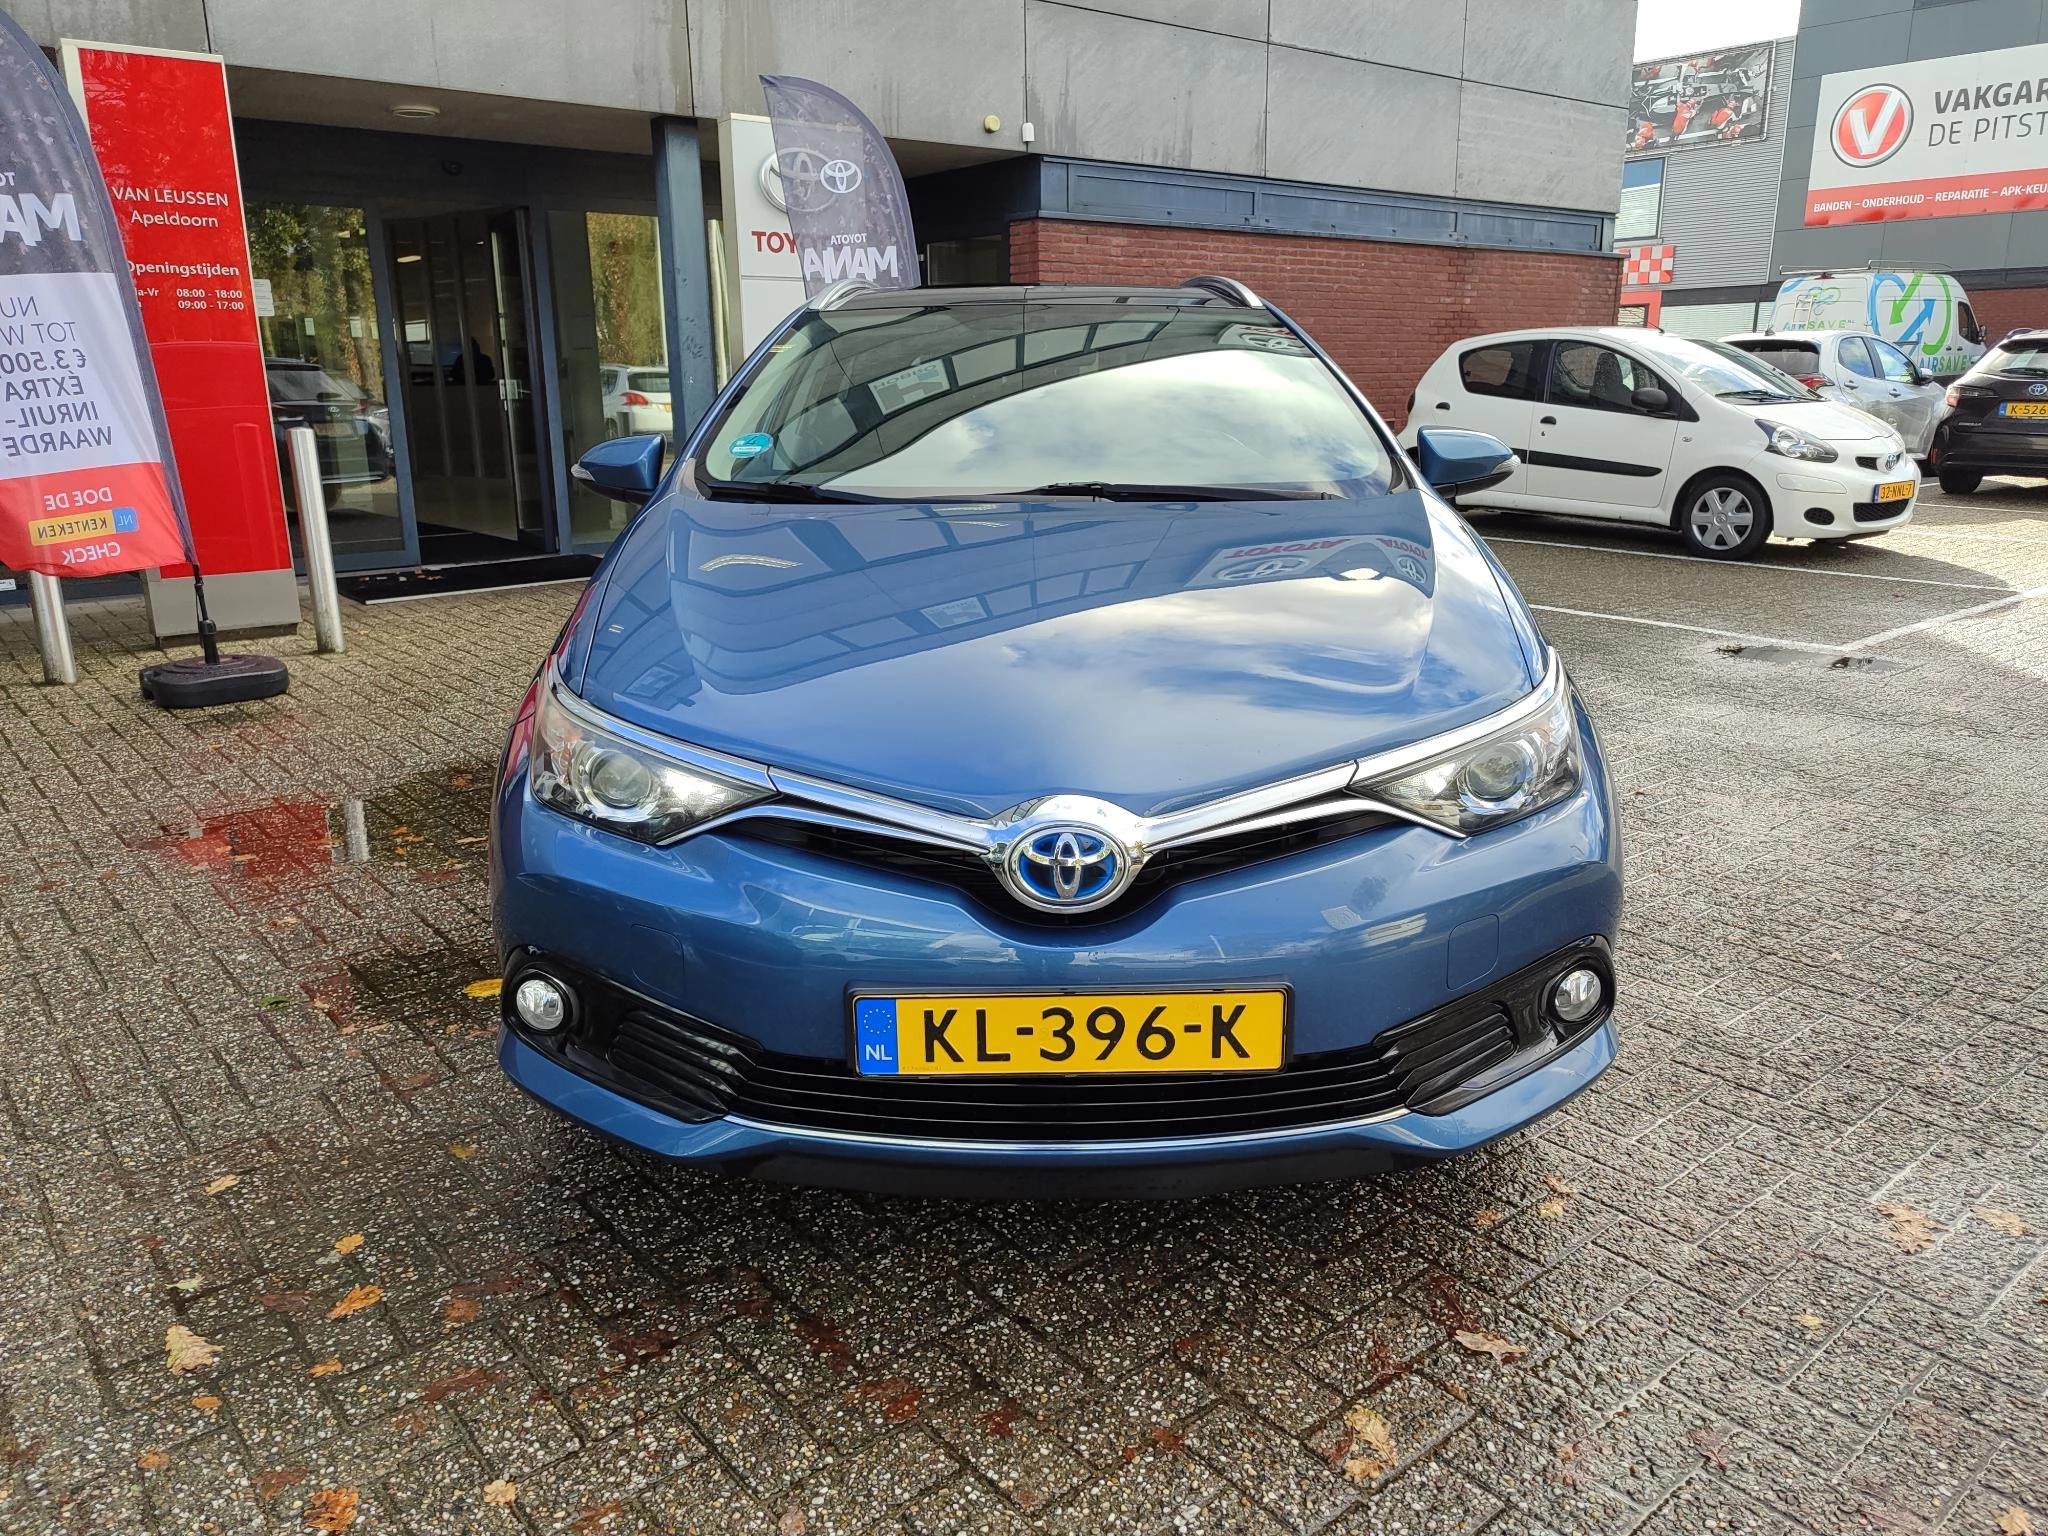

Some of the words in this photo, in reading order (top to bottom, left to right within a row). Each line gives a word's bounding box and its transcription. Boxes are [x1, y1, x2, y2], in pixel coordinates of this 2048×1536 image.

[1928, 120, 1963, 147] DE
[1973, 111, 2048, 143] PITST
[112, 186, 150, 202] VAN
[154, 188, 229, 207] LEUSSEN
[1813, 200, 1852, 213] BANDEN
[1862, 193, 1925, 209] ONDERHOUD
[1935, 188, 1991, 203] REPARATIE
[2000, 182, 2048, 198] APK-KEU
[130, 209, 219, 228] Apeldoorn
[134, 287, 160, 298] a-Vr
[176, 288, 206, 299] 08:00
[214, 289, 243, 300] 18:00
[178, 300, 207, 311] 09:00
[217, 301, 245, 311] 17:00
[866, 1044, 893, 1061] NL
[923, 1004, 1251, 1063] KL-396-K
